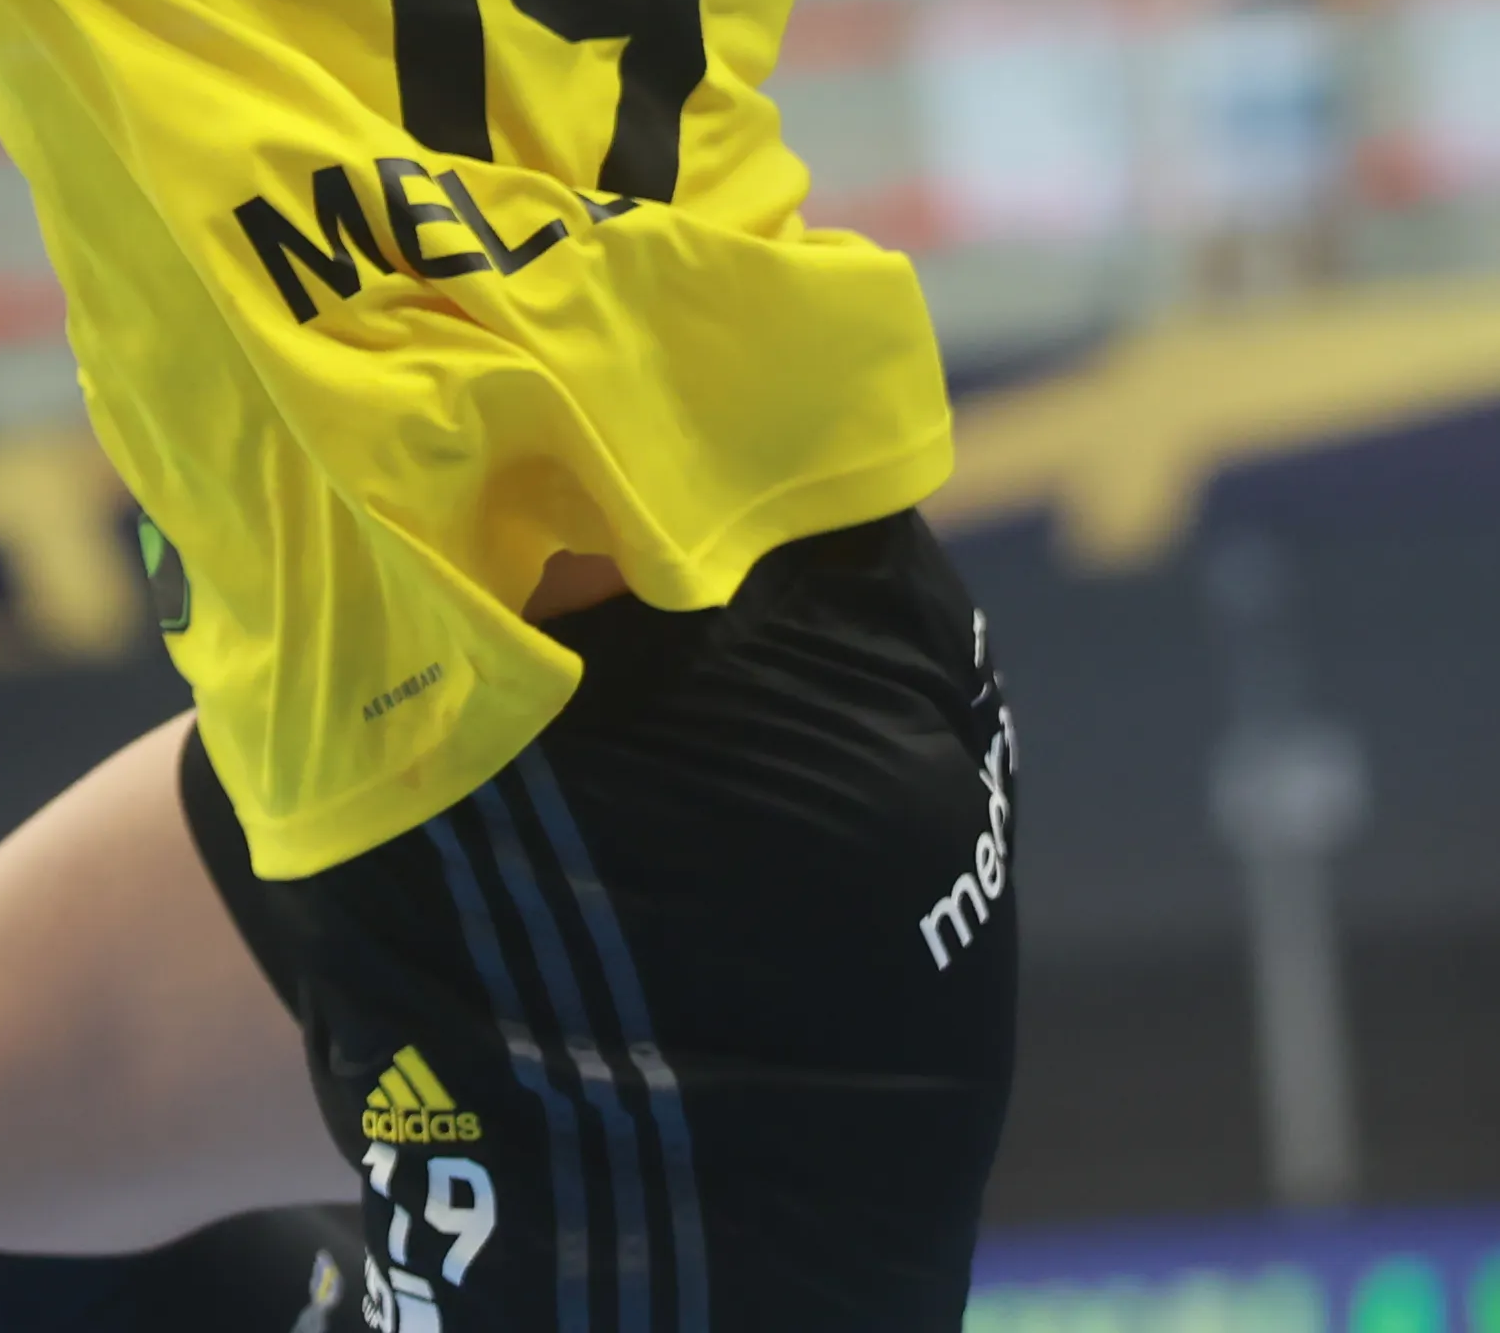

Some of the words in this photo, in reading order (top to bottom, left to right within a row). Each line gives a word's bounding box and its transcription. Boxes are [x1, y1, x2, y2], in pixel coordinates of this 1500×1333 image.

[232, 157, 642, 325] MEL
[361, 1108, 483, 1144] adidas
[361, 1141, 498, 1287] 19
